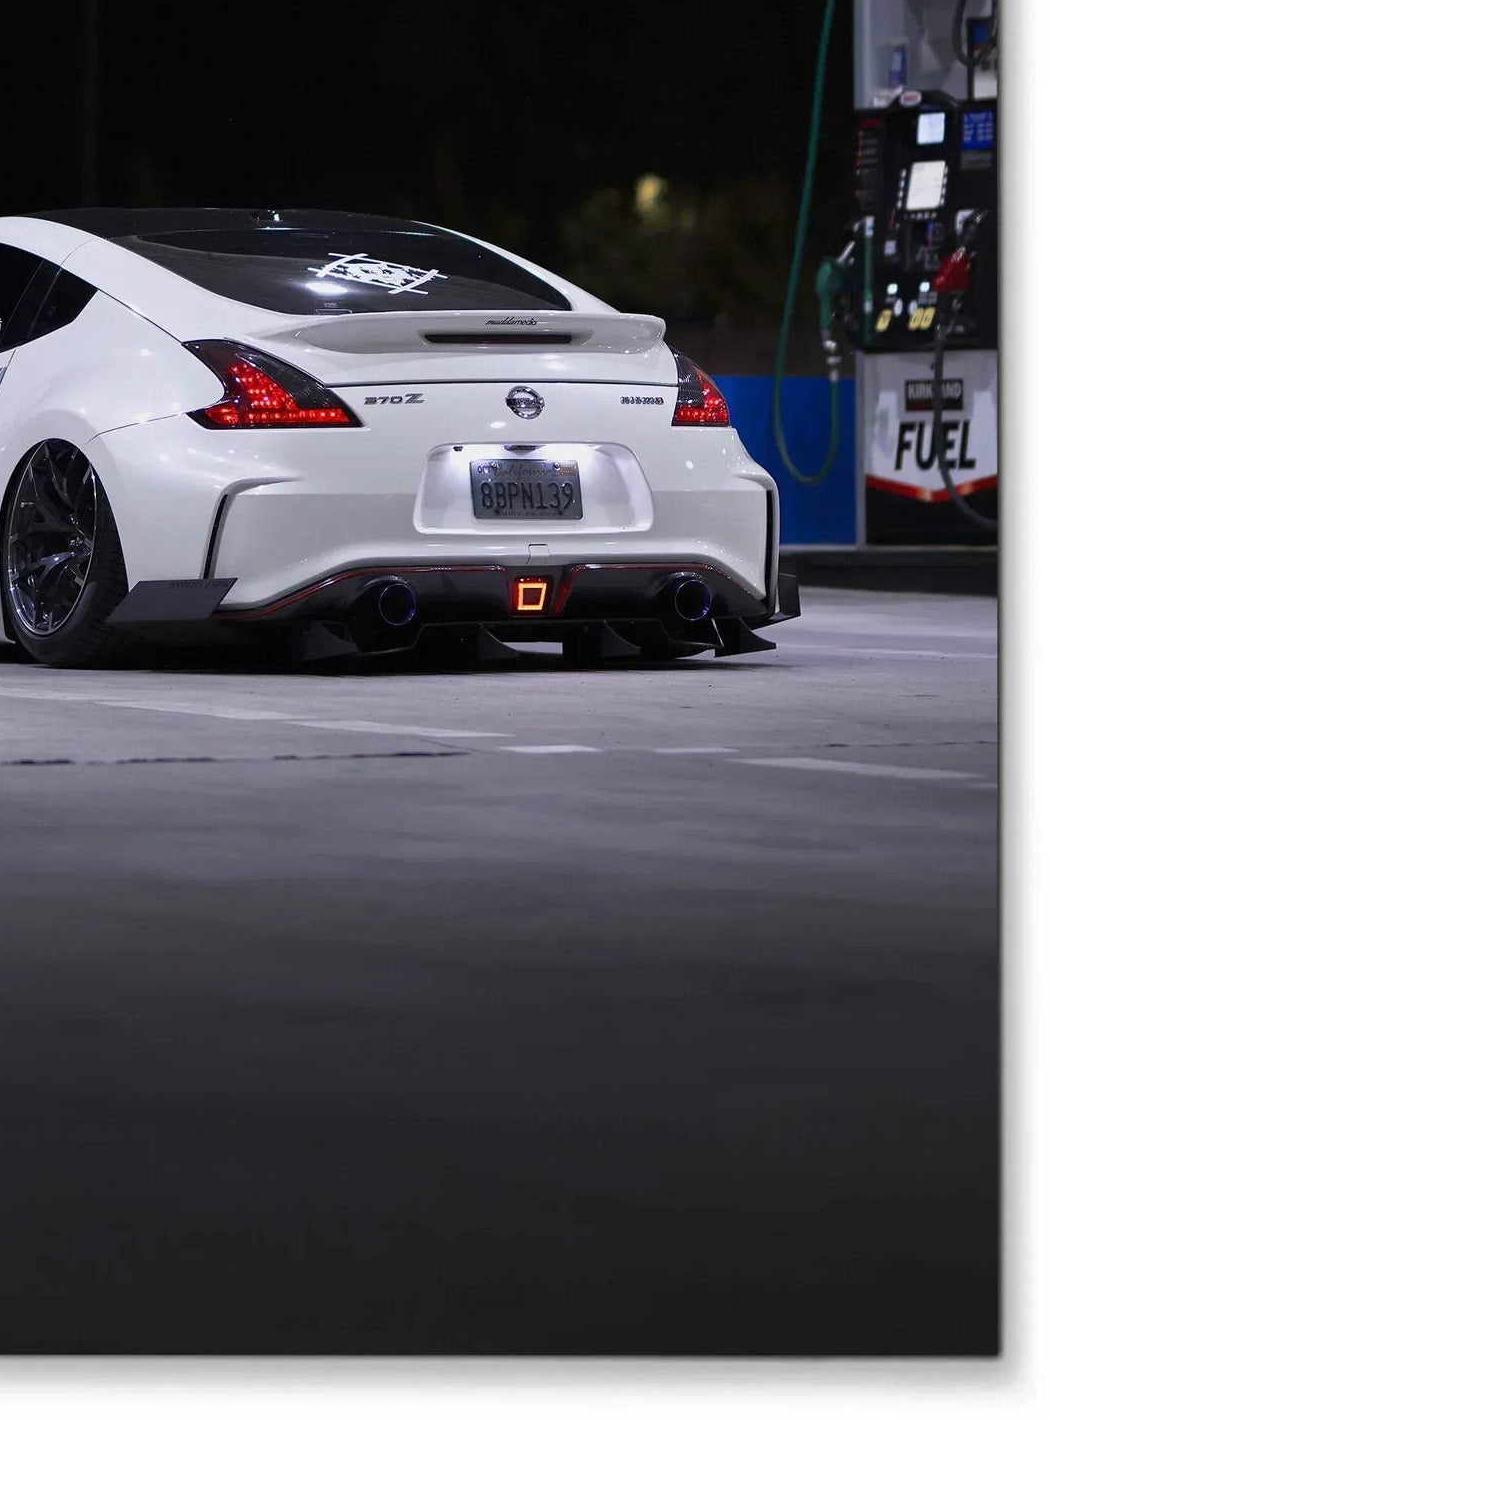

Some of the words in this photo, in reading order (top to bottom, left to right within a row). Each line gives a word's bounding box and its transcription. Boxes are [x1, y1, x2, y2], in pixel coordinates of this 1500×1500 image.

[364, 393, 426, 406] 370Z
[908, 382, 961, 399] KIRKAND
[895, 419, 977, 470] FUEL
[481, 481, 573, 510] 8BPN139
